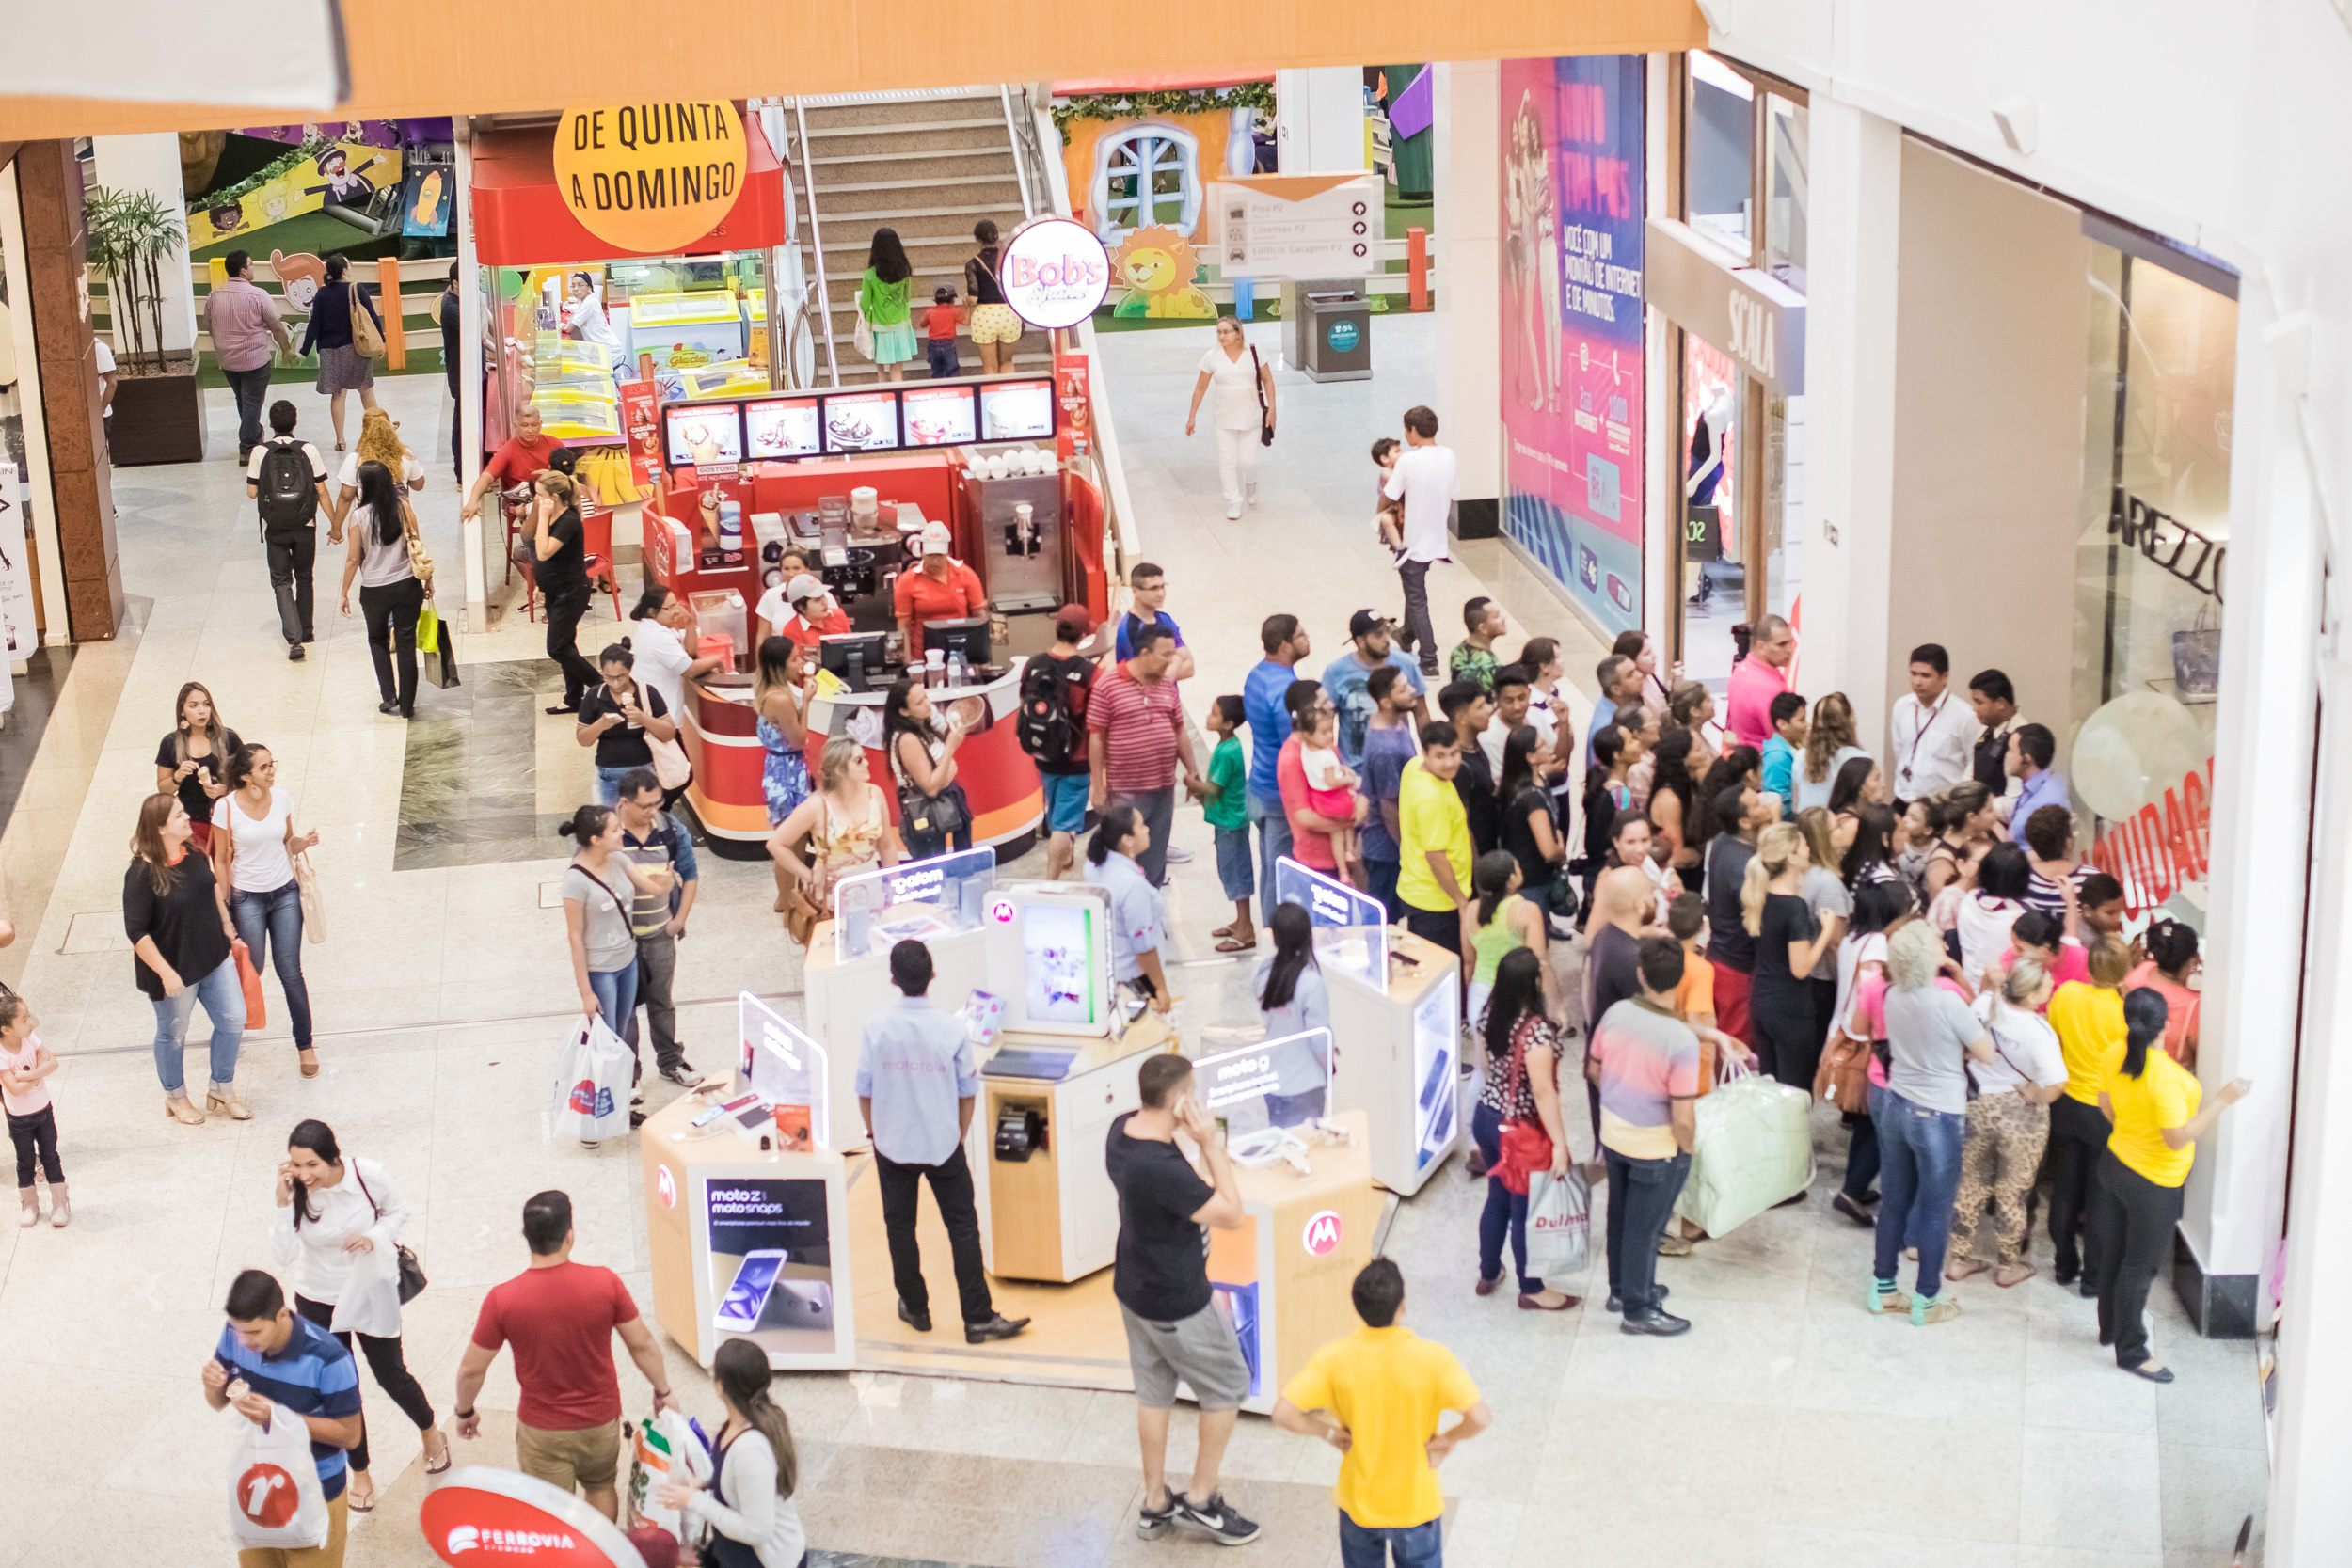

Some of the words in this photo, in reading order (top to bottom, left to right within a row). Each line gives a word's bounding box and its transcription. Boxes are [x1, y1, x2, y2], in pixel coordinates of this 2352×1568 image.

[575, 110, 605, 150] DE
[619, 103, 729, 151] QUINTA
[572, 174, 588, 209] A
[592, 162, 735, 211] DOMINGO
[1272, 204, 1283, 213] P2
[1252, 226, 1292, 234] Cinemas
[1564, 223, 1582, 253] VOCÊ
[1582, 229, 1599, 260] COM
[1599, 232, 1613, 261] UM
[1289, 245, 1328, 255] Garagem
[1594, 261, 1605, 290] DE
[1605, 264, 1642, 298] INTERNET
[1566, 283, 1572, 309] E
[1572, 285, 1582, 312] DE
[1728, 288, 1775, 379] SCALA
[669, 353, 710, 366] Glacial
[481, 1527, 575, 1550] FERROVIA
